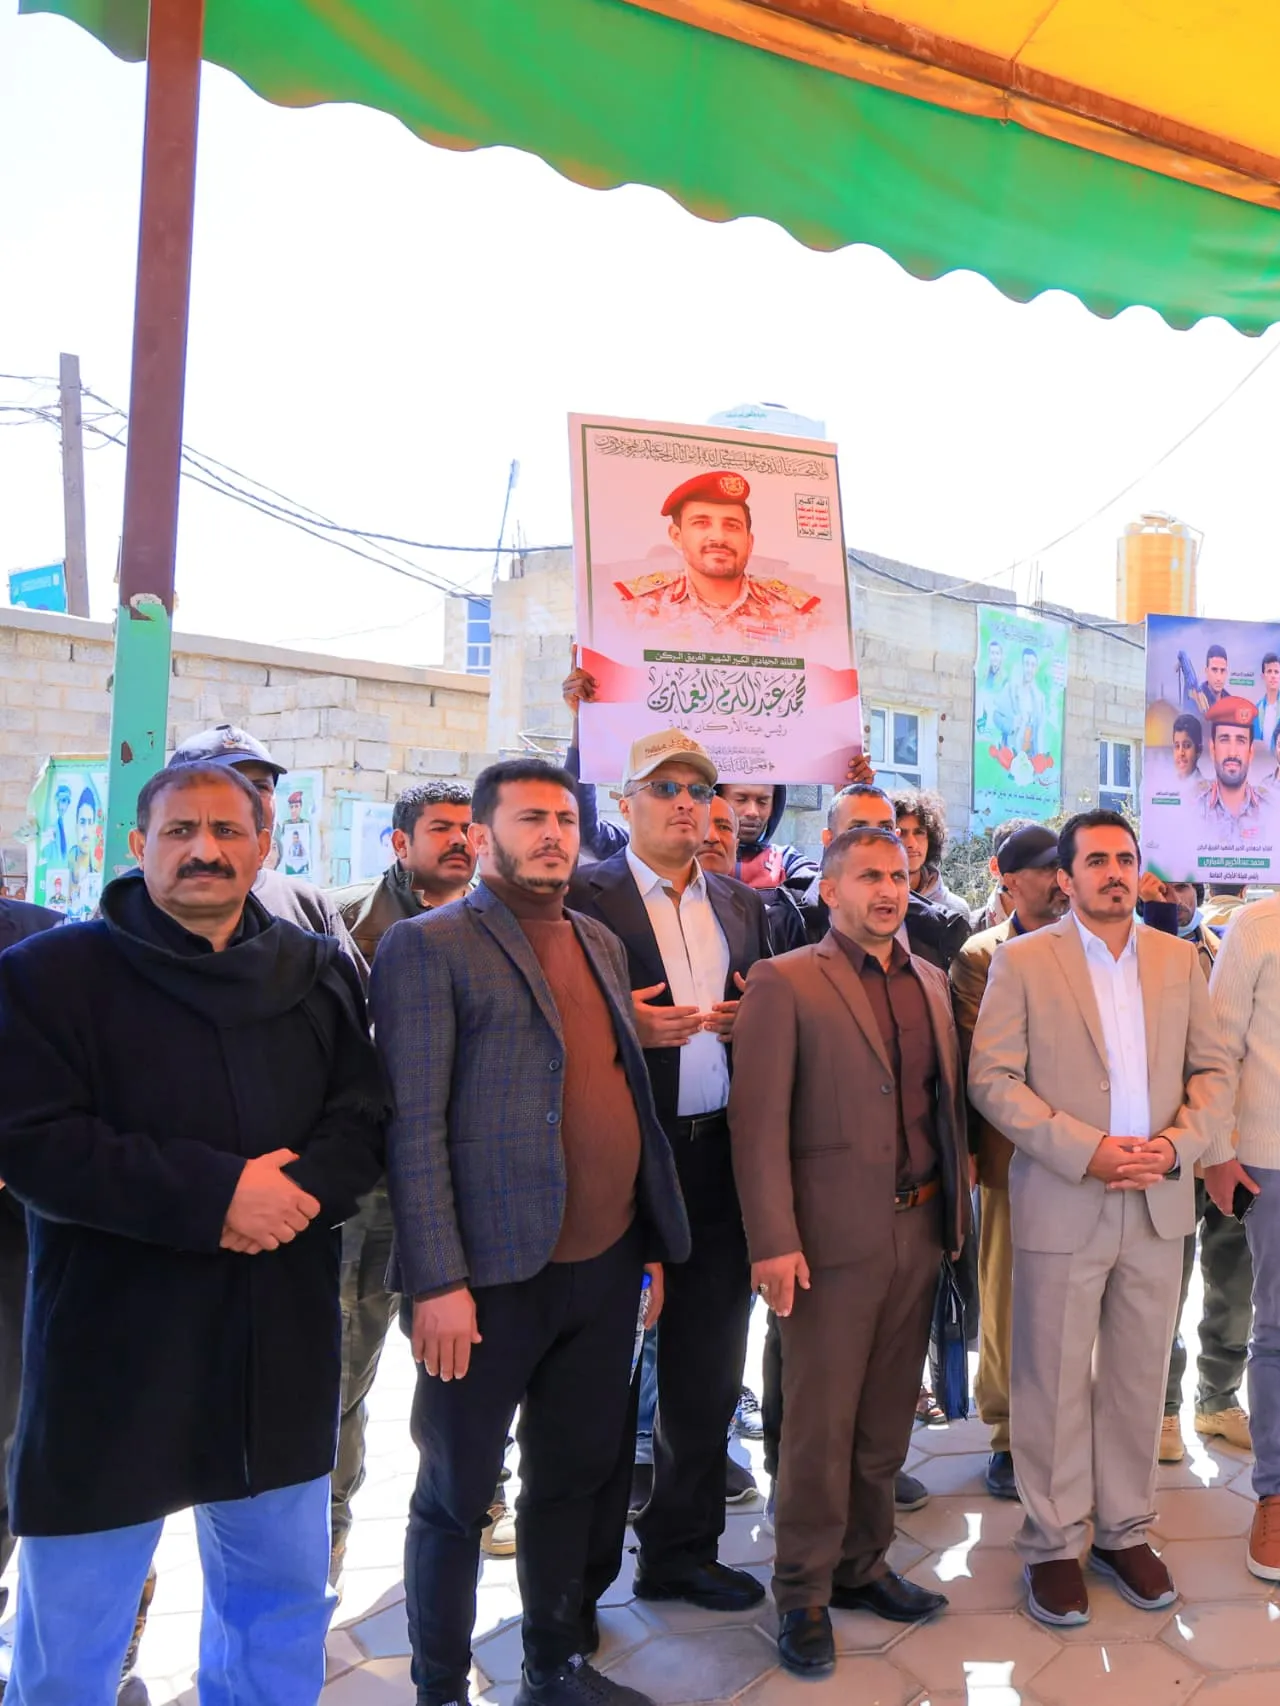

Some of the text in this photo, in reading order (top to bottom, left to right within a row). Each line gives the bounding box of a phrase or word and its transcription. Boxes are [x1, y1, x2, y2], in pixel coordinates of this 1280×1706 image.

[685, 653, 706, 663] الفريق
[710, 655, 732, 664] الشهيد
[732, 656, 749, 665] الكبير
[751, 657, 778, 667] الجهادي
